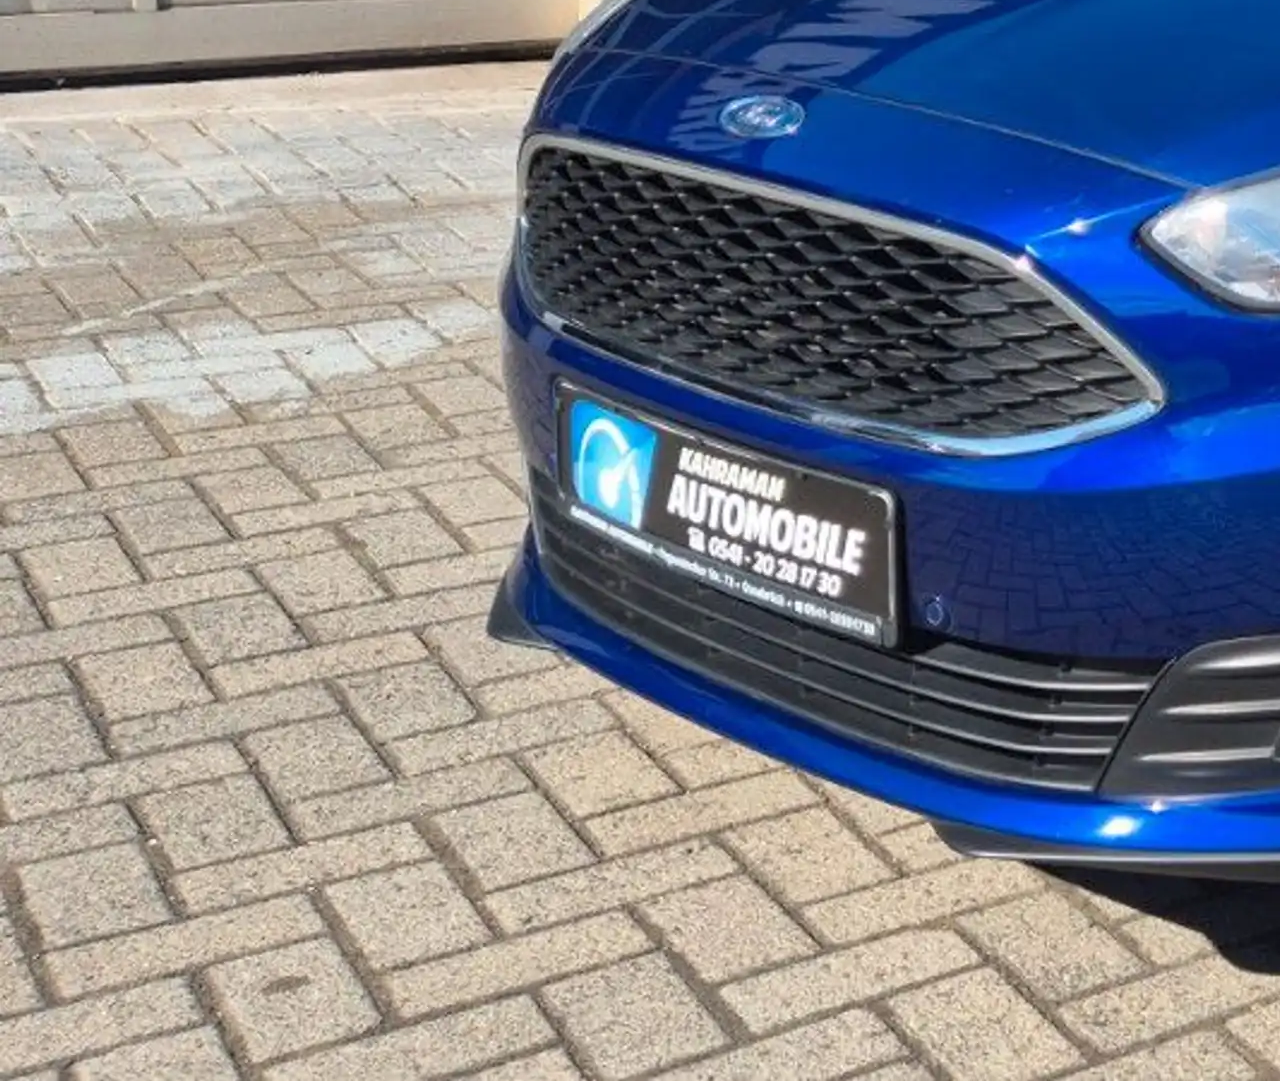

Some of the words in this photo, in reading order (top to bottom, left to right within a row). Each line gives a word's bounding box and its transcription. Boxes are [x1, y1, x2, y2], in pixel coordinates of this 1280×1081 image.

[678, 447, 787, 502] KAHRAMAN
[666, 473, 867, 577] AUTOMOBILE
[752, 549, 775, 576] 20
[816, 571, 842, 599] 30
